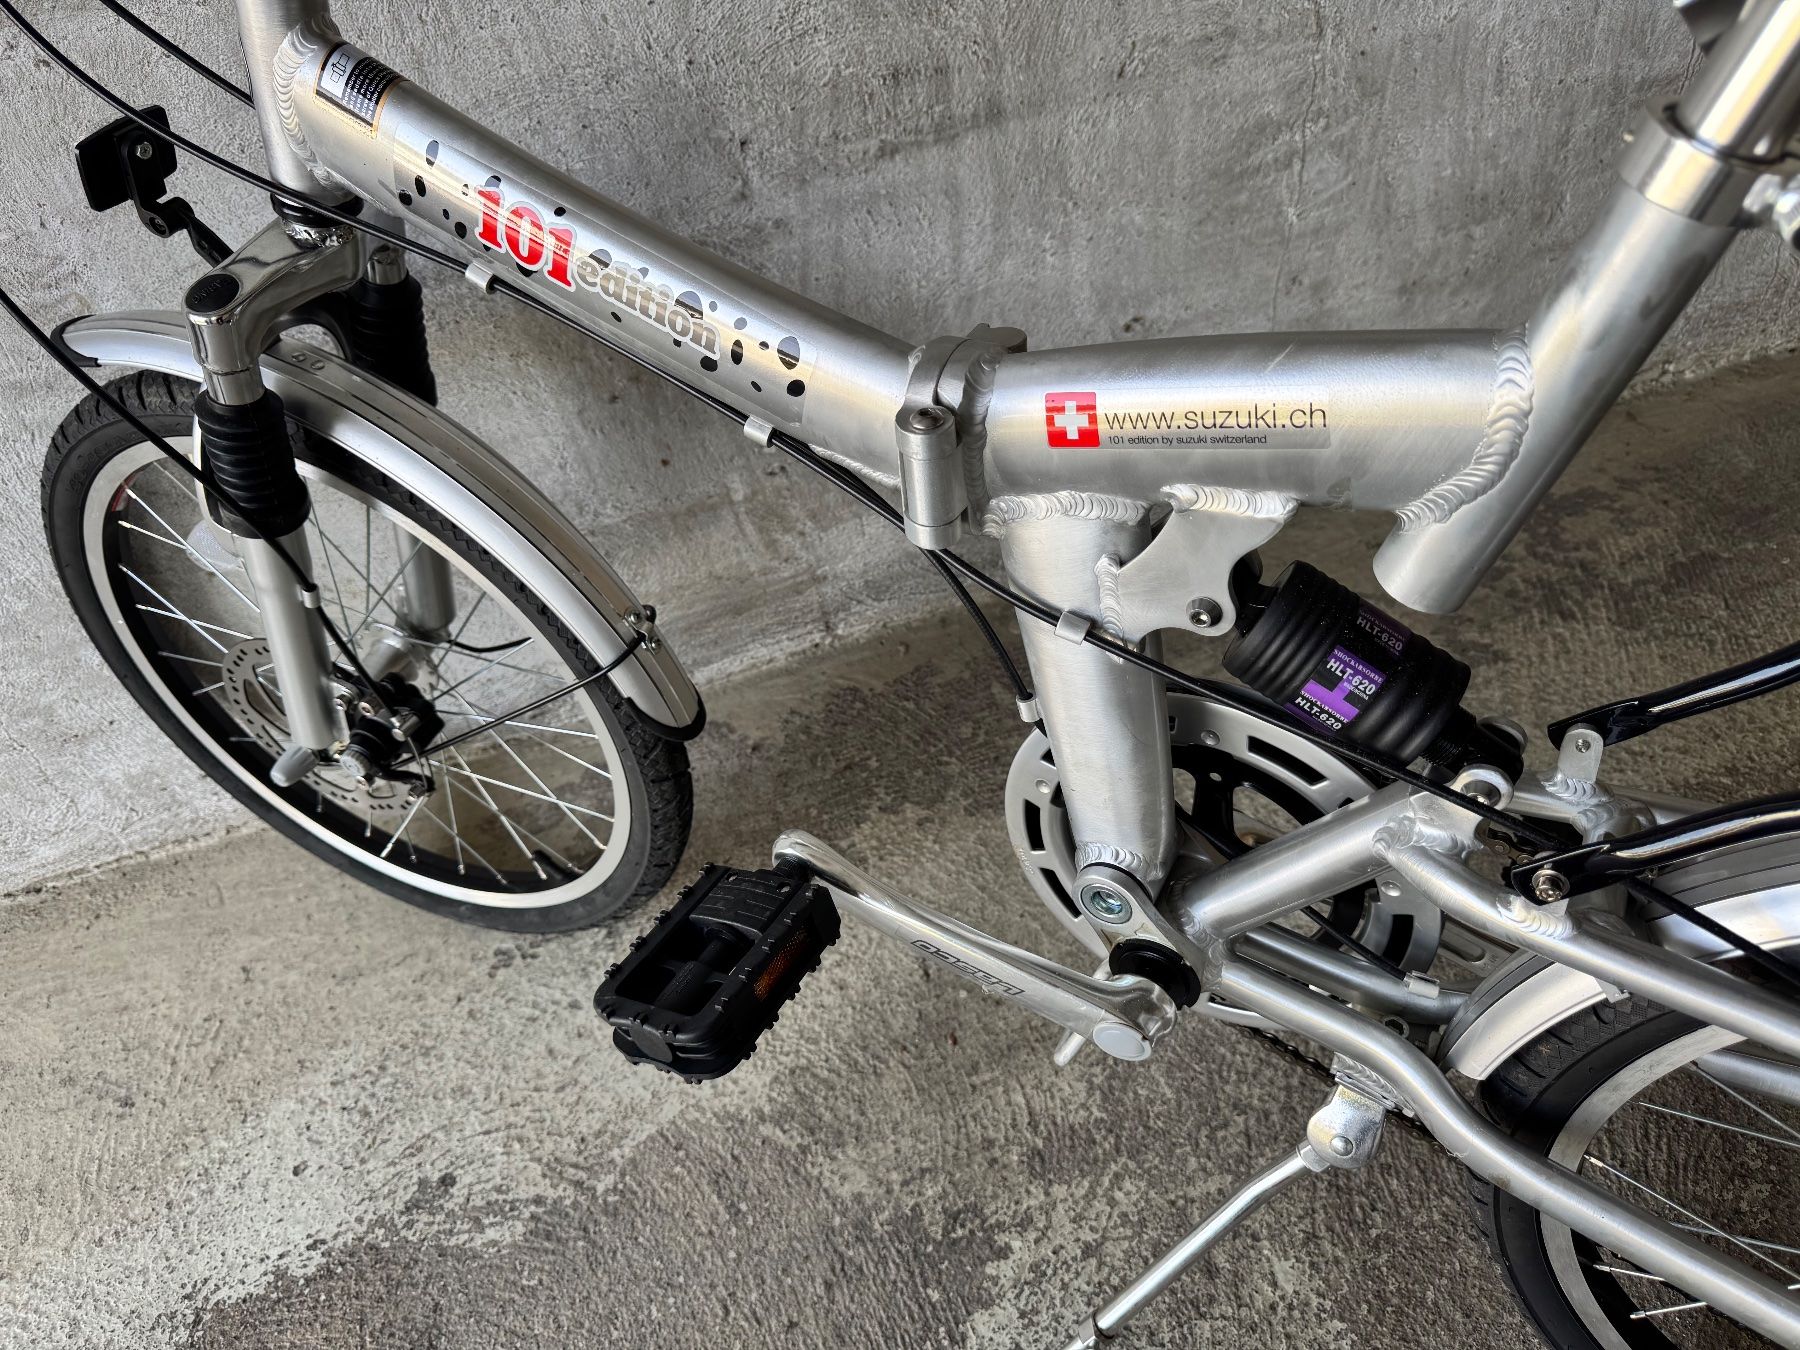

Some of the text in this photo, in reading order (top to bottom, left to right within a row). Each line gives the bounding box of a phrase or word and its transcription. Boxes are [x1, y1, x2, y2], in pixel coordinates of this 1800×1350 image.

[475, 186, 720, 360] 101 edition
[1104, 402, 1328, 430] www.suzuki.ch
[1108, 434, 1267, 447] 101 edition by suzuki switzerland
[1356, 616, 1404, 652] HLT-620
[1326, 658, 1376, 695] HLT-620
[1295, 696, 1342, 731] HLT-620
